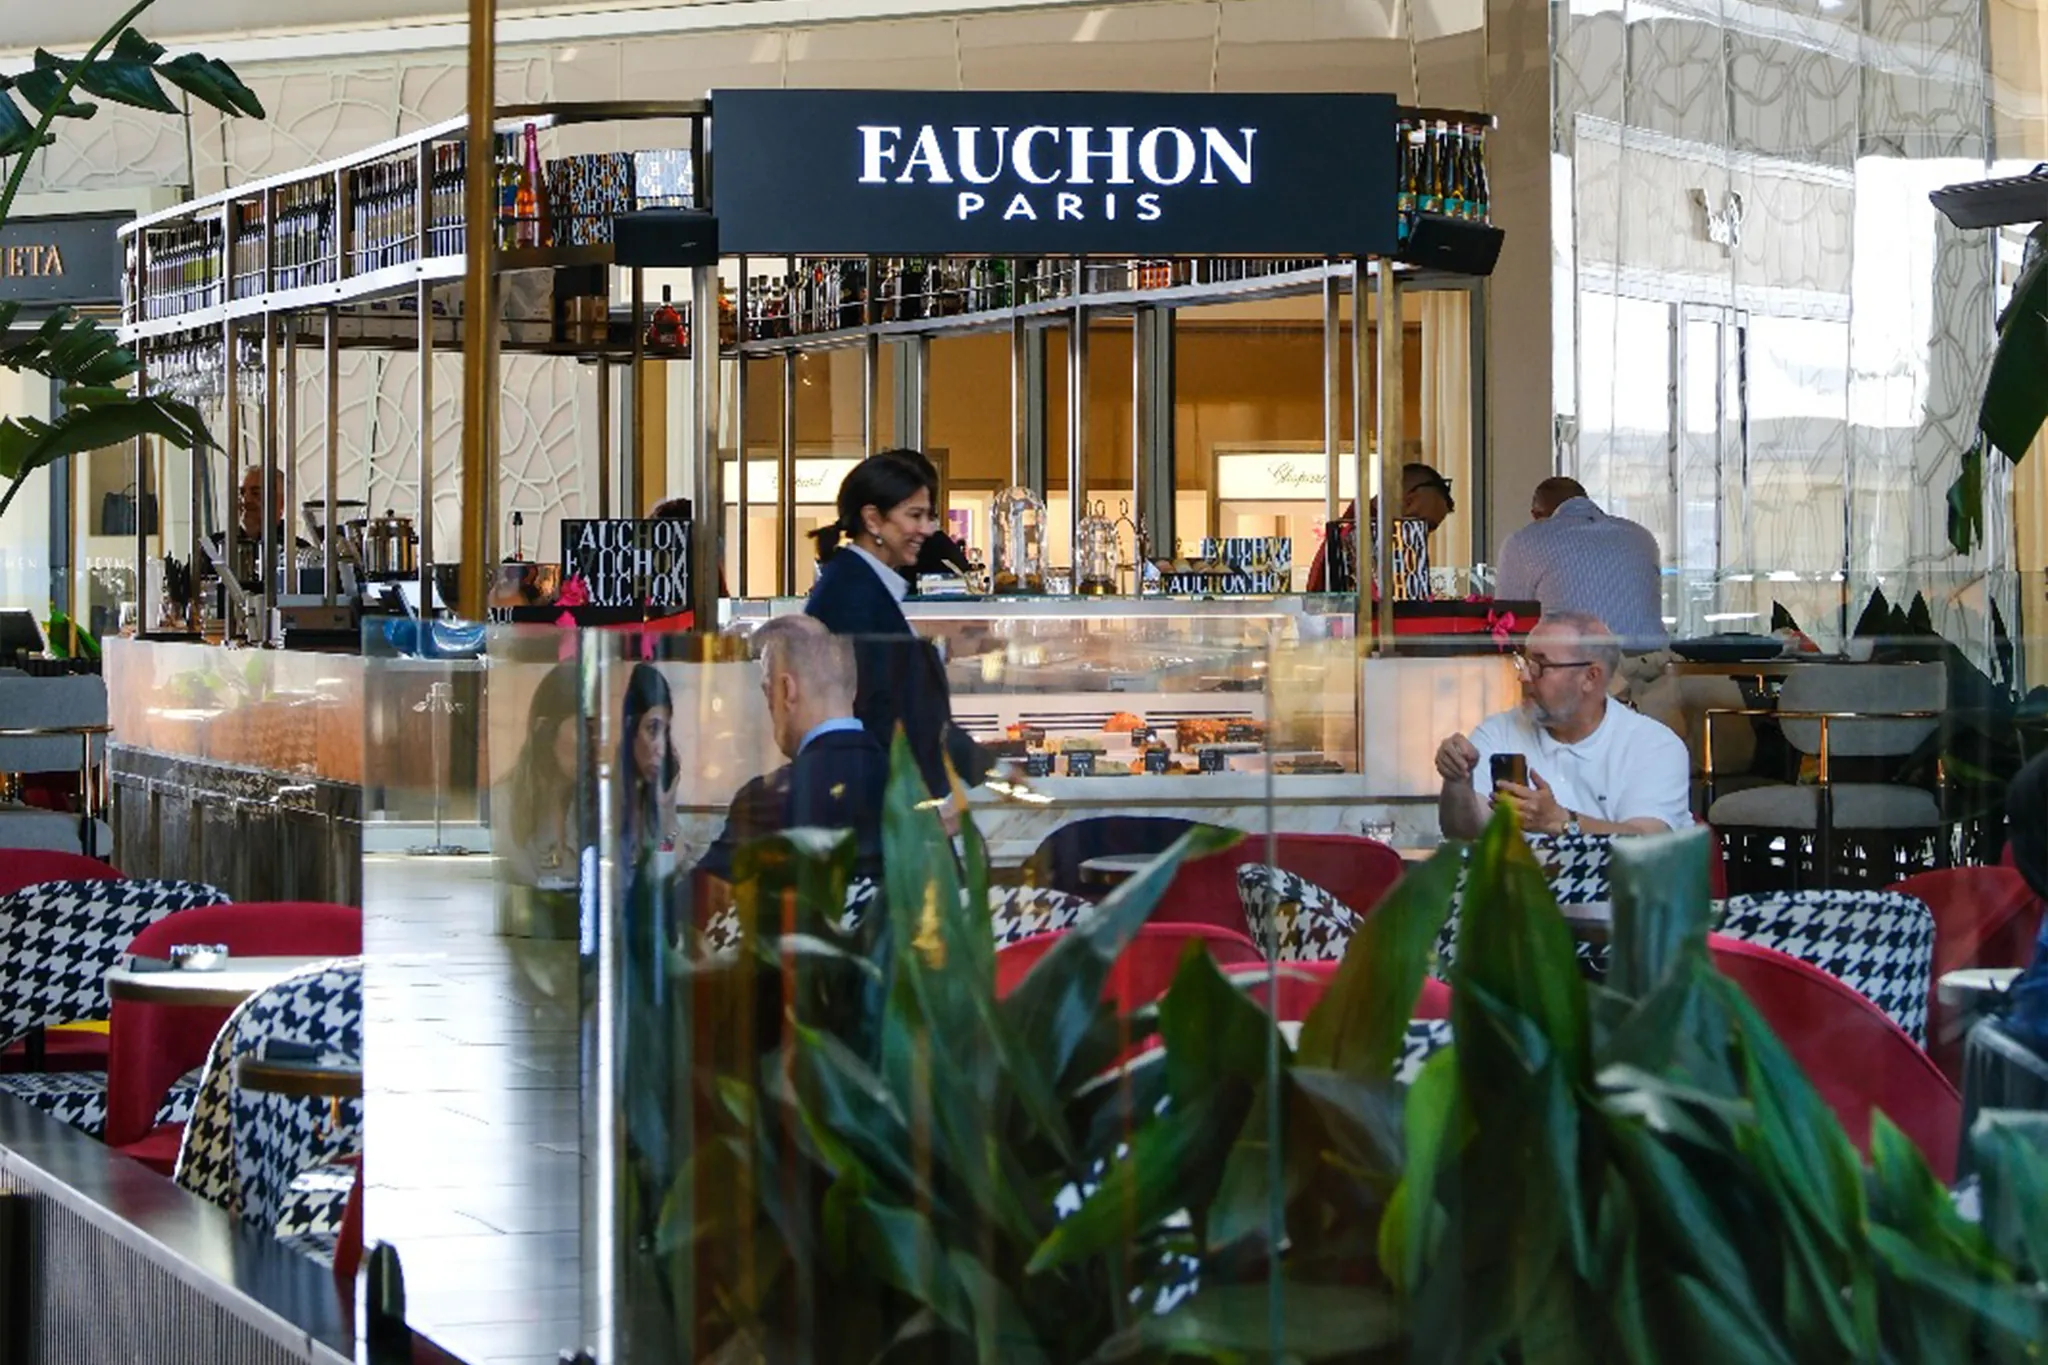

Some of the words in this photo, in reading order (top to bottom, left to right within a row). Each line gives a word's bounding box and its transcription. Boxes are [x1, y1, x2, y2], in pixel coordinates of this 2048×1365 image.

[857, 125, 1258, 185] FAUCHON
[957, 192, 1162, 221] PARIS
[564, 520, 690, 549] FAUCHON
